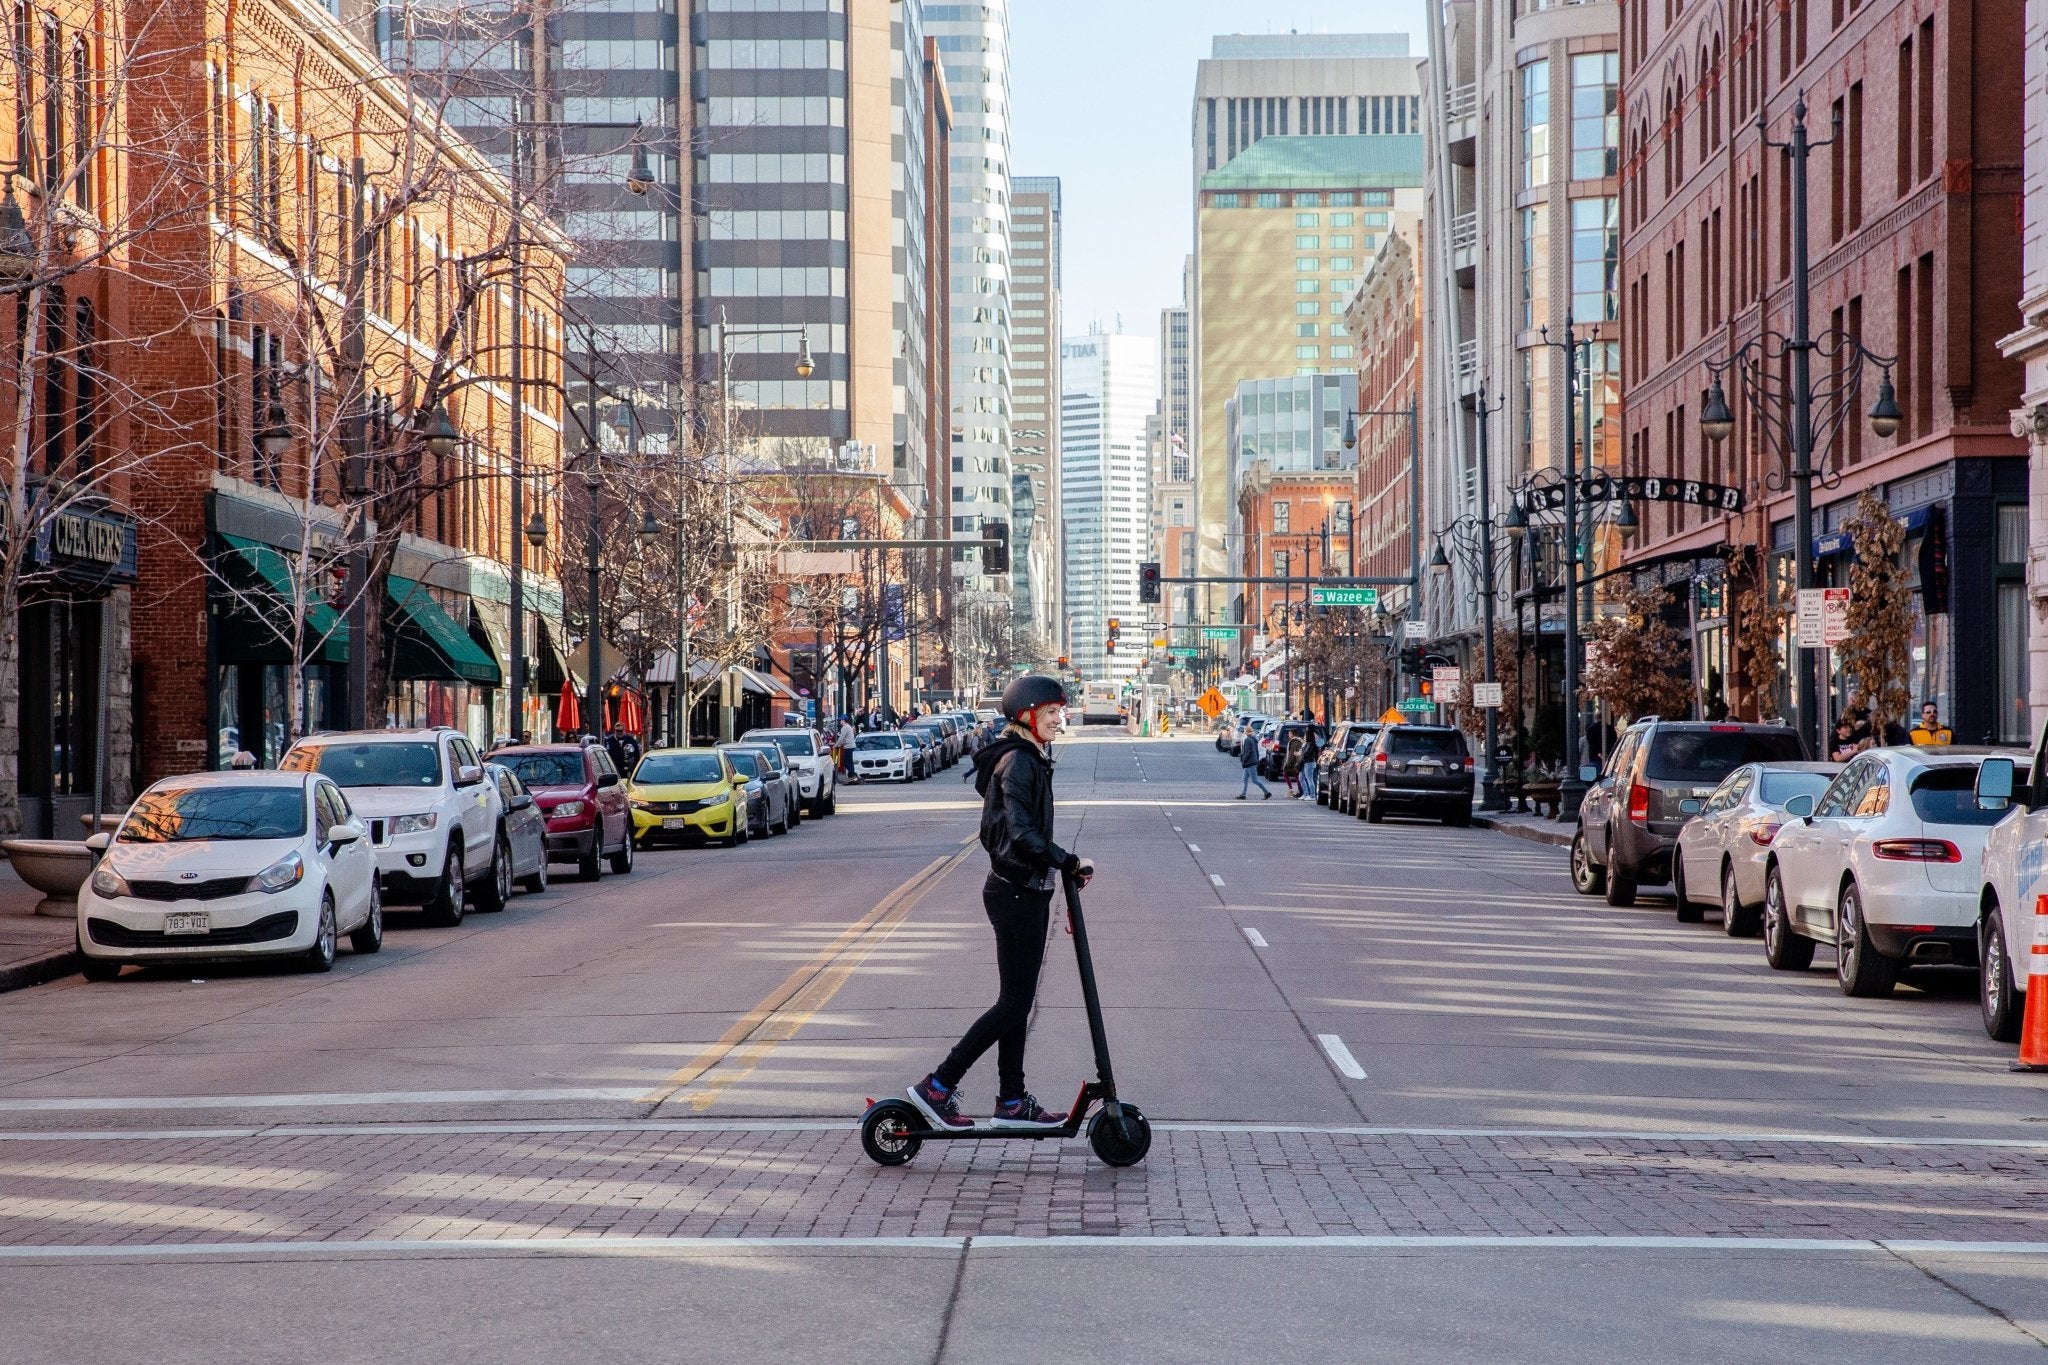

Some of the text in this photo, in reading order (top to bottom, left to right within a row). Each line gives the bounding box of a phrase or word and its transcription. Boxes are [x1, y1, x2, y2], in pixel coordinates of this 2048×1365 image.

[1071, 343, 1097, 358] TIAA
[56, 513, 123, 564] CLEANERS
[1326, 591, 1362, 602] Wazee
[1209, 630, 1228, 639] Blake
